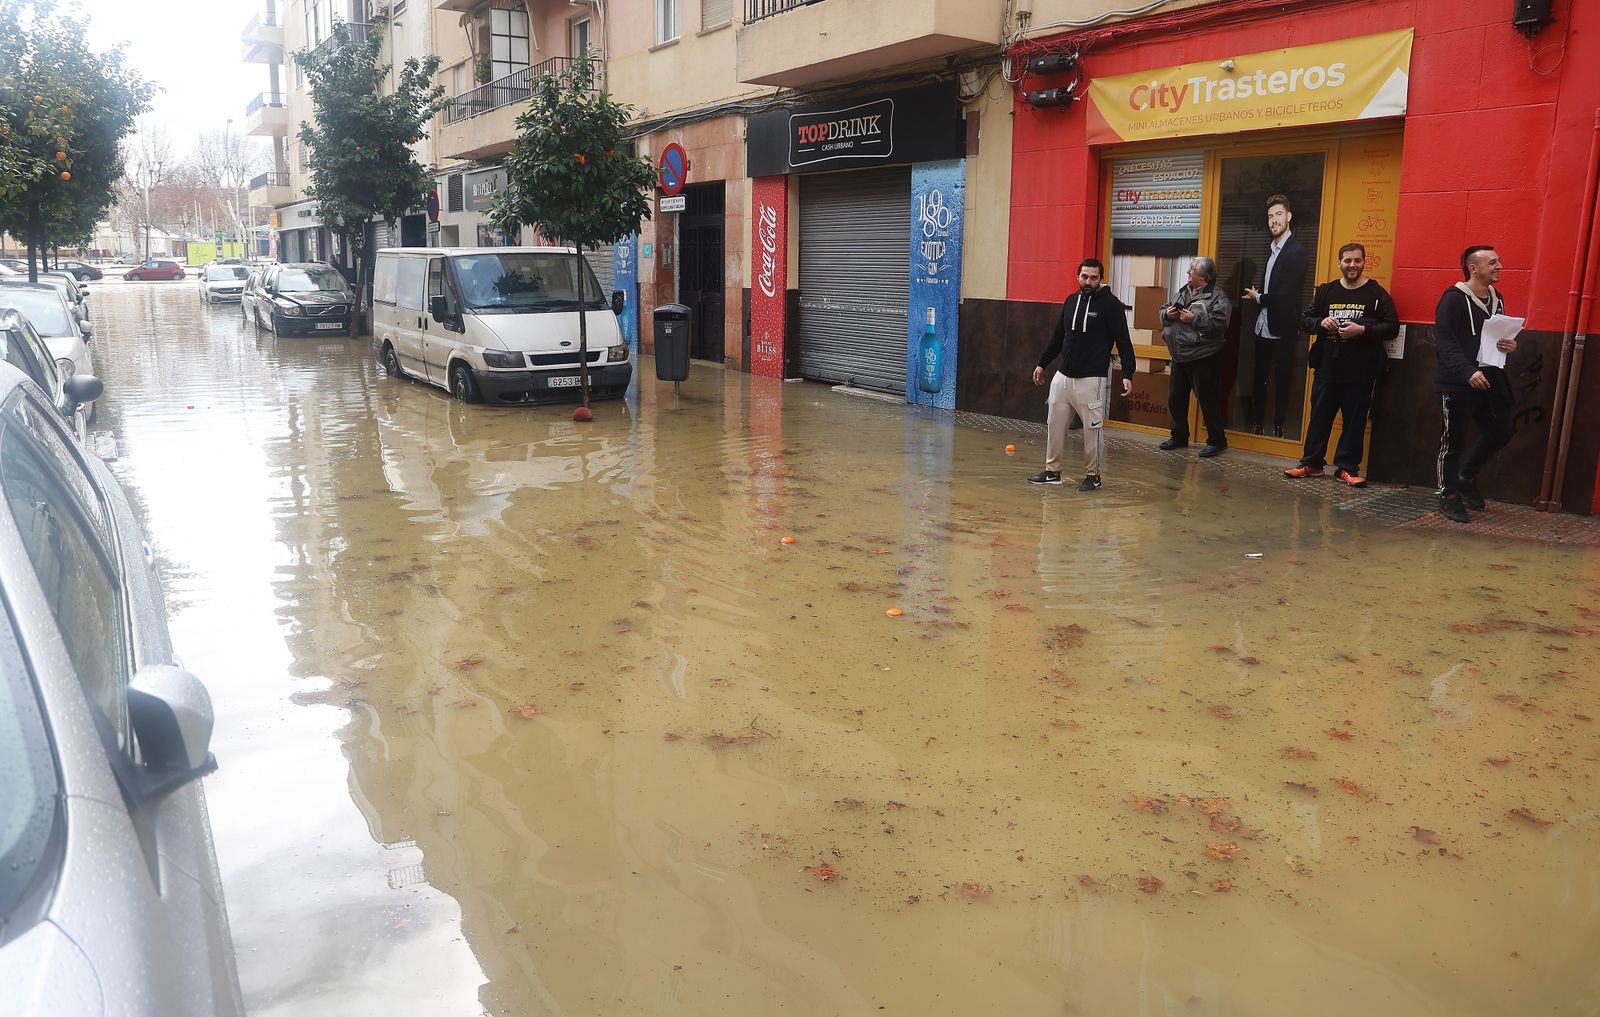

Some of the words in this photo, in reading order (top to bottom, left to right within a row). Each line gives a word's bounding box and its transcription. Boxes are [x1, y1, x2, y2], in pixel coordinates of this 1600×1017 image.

[1128, 62, 1346, 113] CityTrasteros
[1128, 121, 1148, 131] MINI
[1149, 115, 1204, 129] ALMACENES
[1205, 109, 1254, 124] URBANOS
[1256, 108, 1263, 119] Y
[1265, 99, 1344, 117] BICICLETEROS
[821, 143, 834, 152] CASH
[834, 141, 854, 150] URBANO
[1152, 168, 1199, 183] ESPACIO?
[1117, 187, 1200, 205] CityTrasteros
[1130, 216, 1148, 227] 689
[1151, 216, 1164, 227] 119
[1166, 215, 1182, 227] 315
[552, 377, 573, 387] 6253
